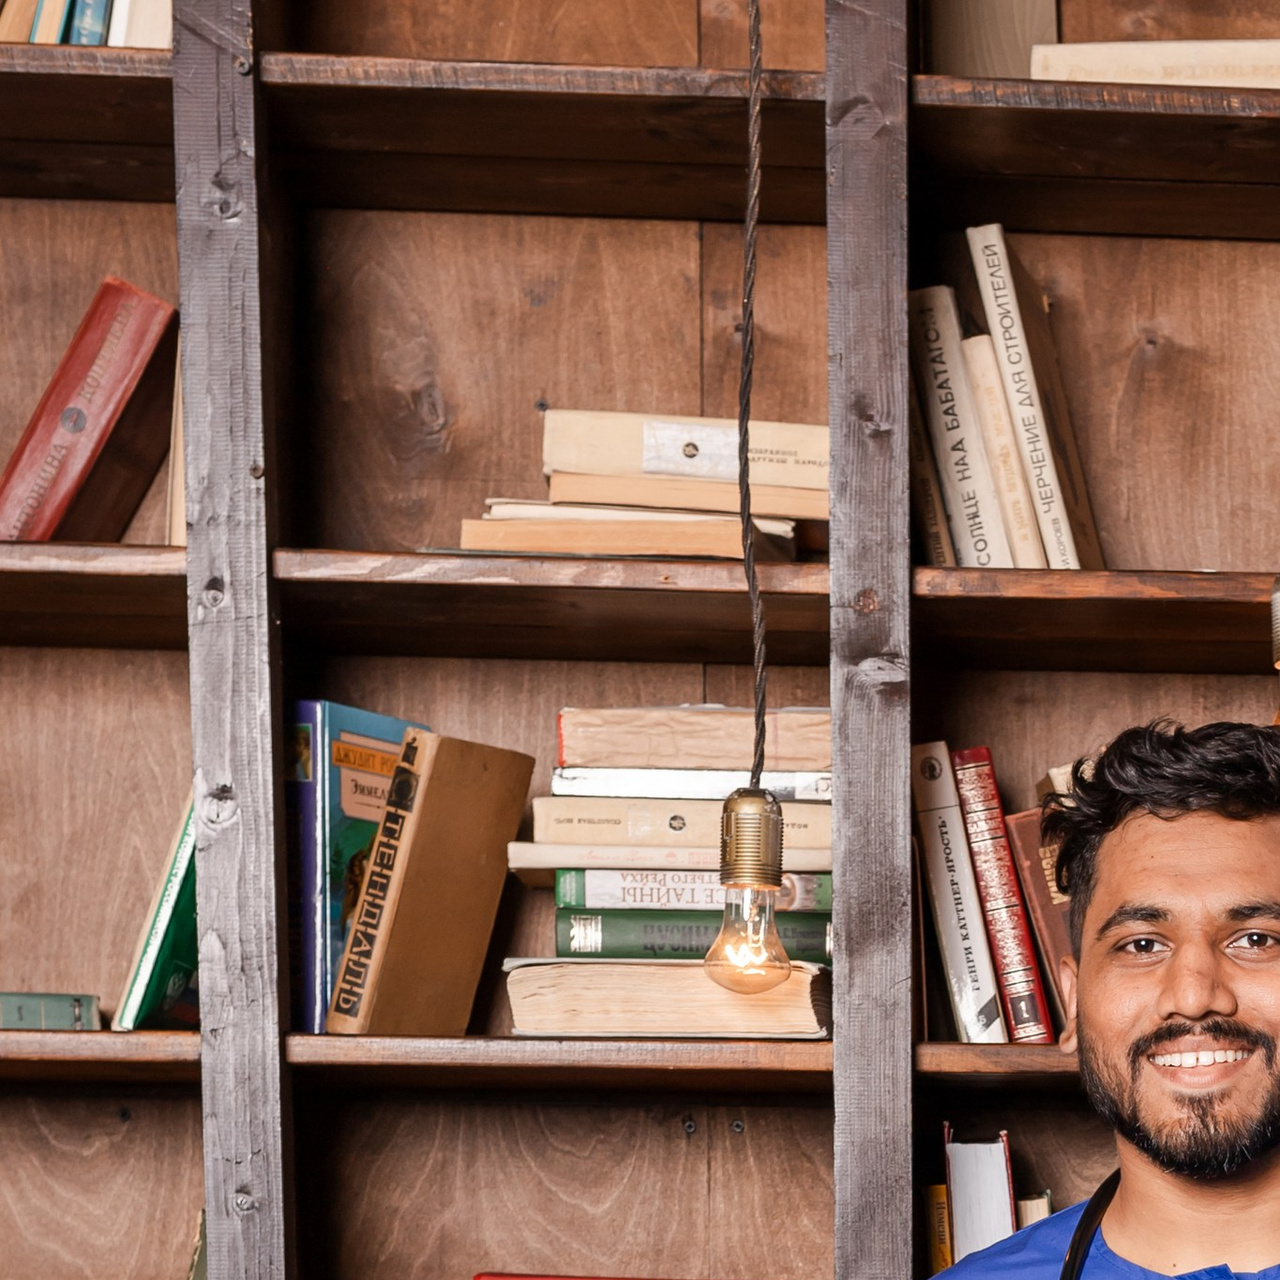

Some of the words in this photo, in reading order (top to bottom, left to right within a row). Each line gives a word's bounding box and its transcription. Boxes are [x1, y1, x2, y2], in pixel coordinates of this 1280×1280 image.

[978, 242, 1023, 365] СТРОИТЕЛЕЙ
[1011, 369, 1034, 410] ДЛЯ
[948, 437, 972, 482] НАД
[1021, 414, 1058, 514] ЧЕРЧЕНИЕ
[960, 488, 993, 568] СОЛНЦЕ
[935, 819, 957, 874] ЯРОСТЬ
[620, 885, 696, 907] ТАЙНЫ
[947, 877, 970, 941] КАТТНЕР
[961, 944, 981, 992] ГЕНРИ
